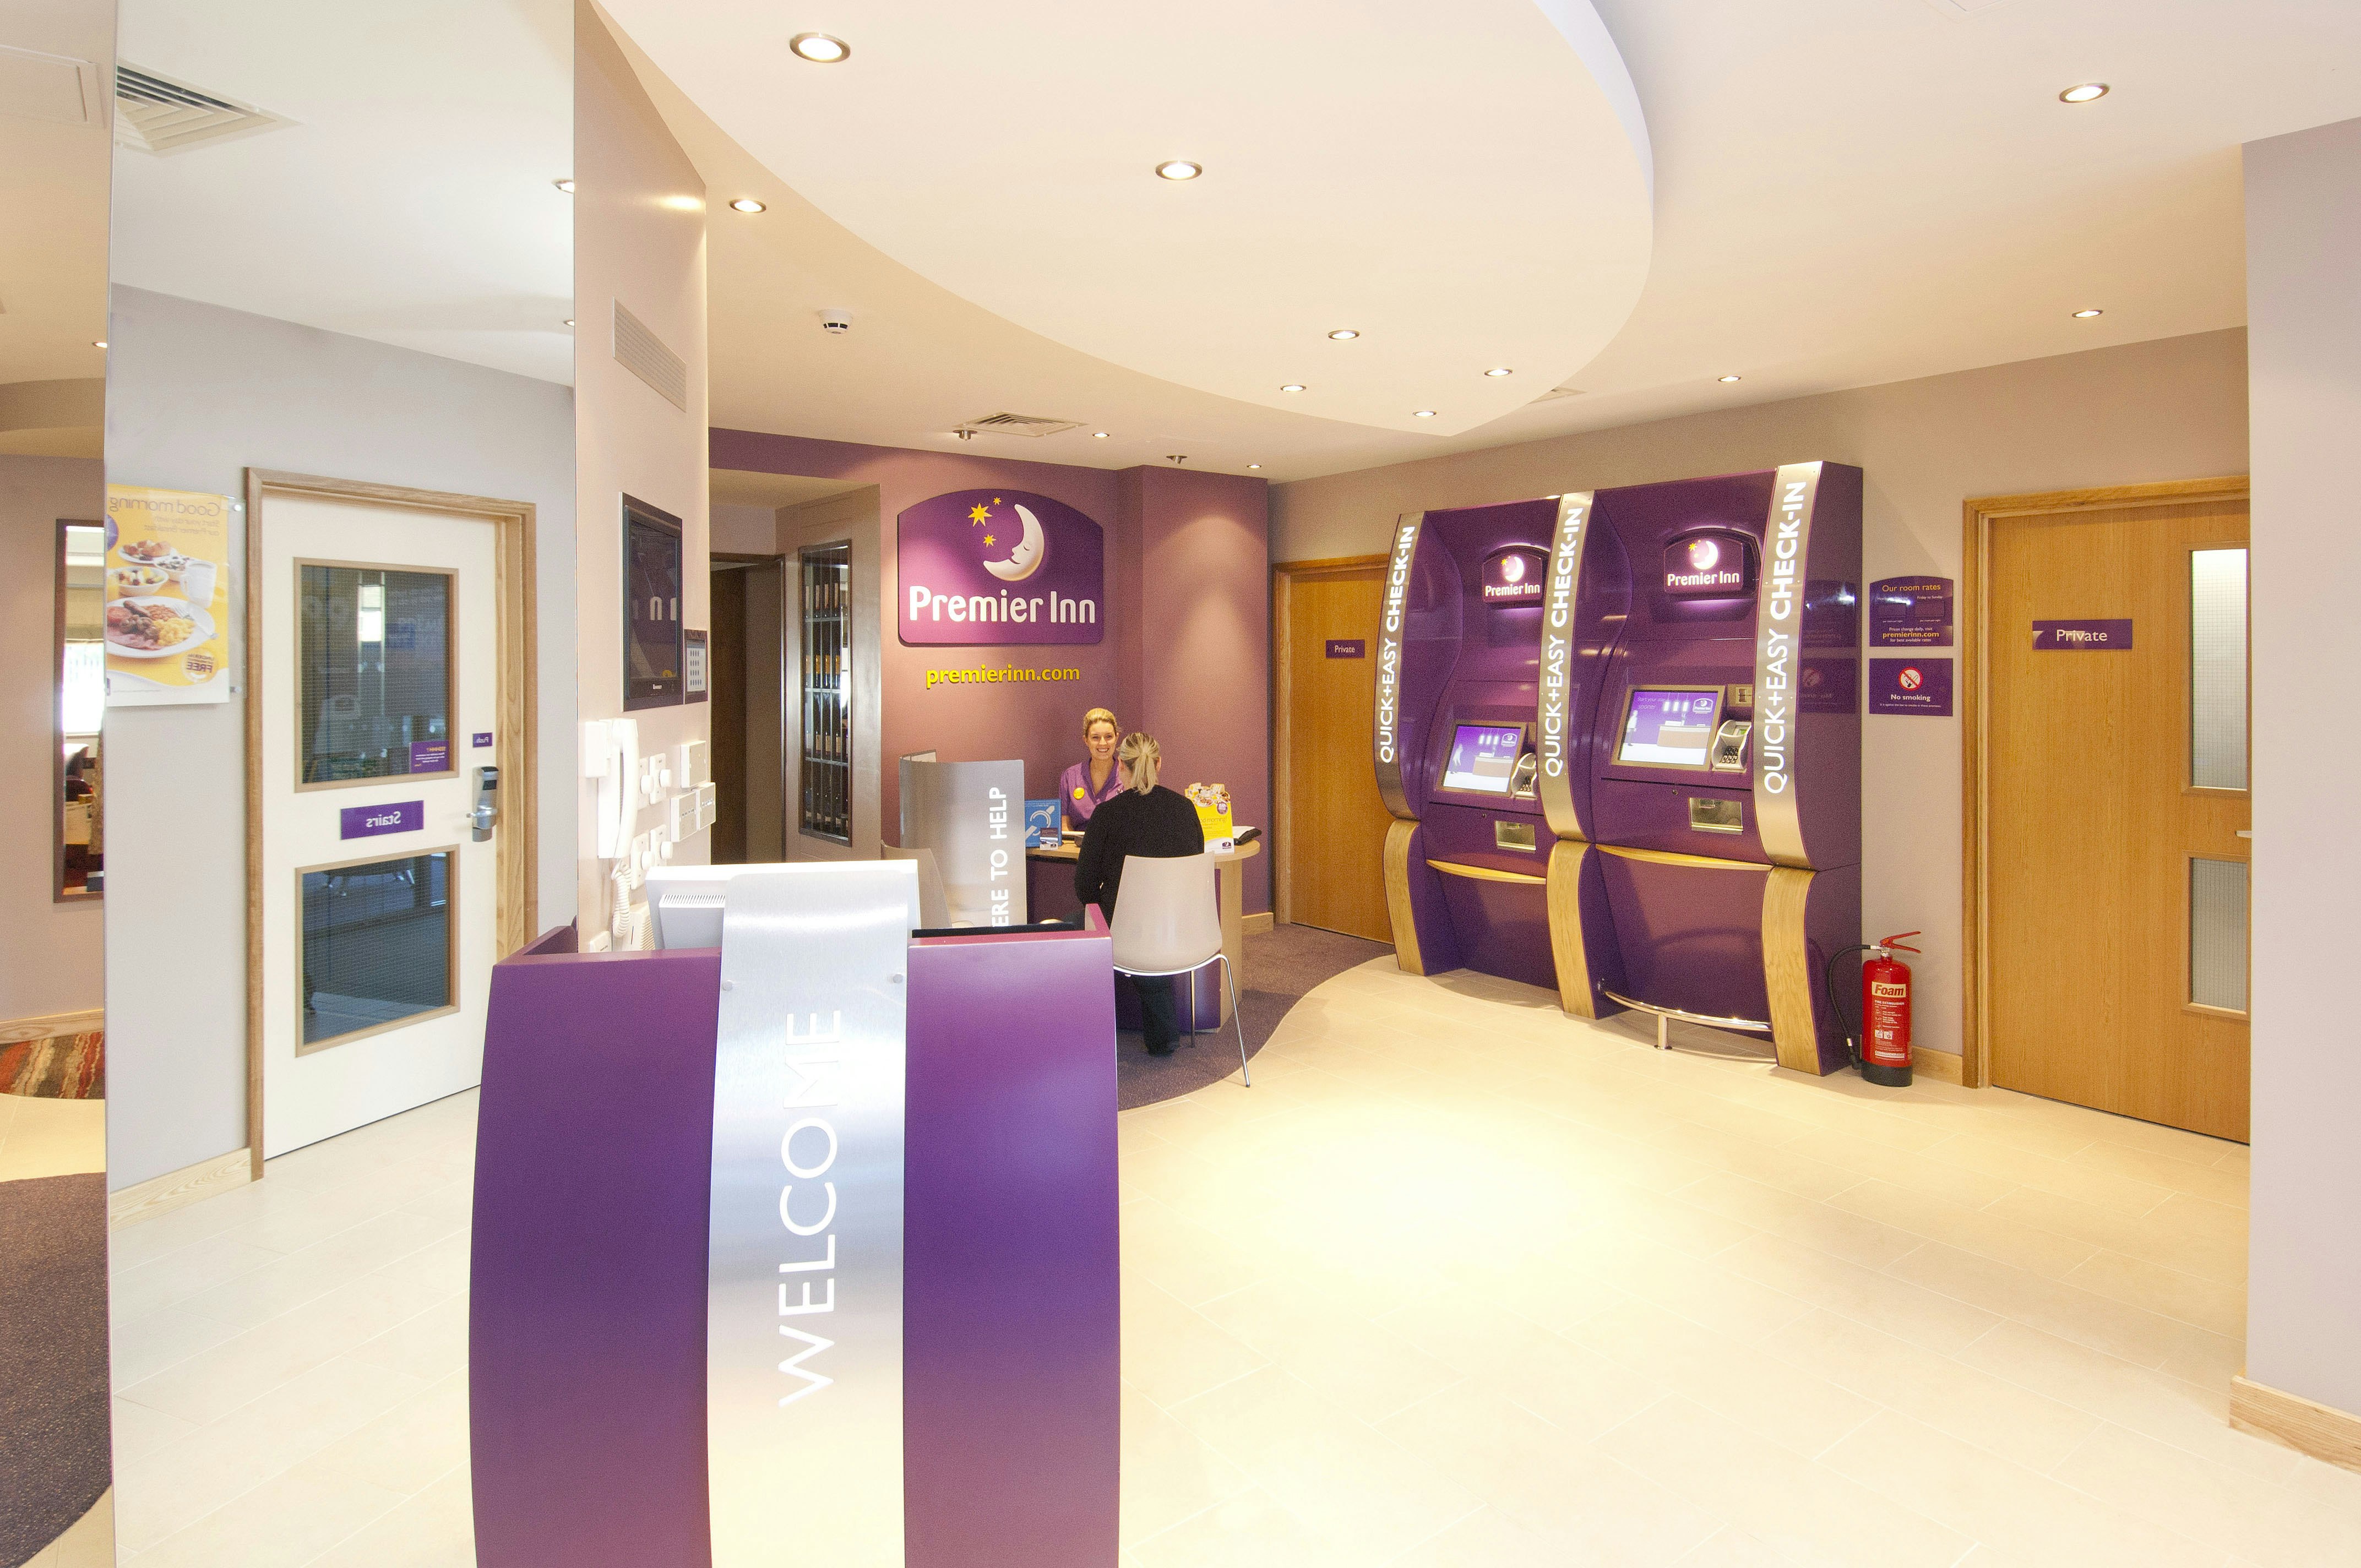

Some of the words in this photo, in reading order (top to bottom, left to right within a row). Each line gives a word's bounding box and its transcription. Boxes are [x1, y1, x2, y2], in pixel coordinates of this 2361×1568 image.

[1551, 508, 1583, 627] CHECK-IN
[1770, 482, 1806, 620] CHECK-IN
[1386, 526, 1415, 632] CHECK-IN
[1485, 583, 1524, 597] Premier
[1525, 582, 1540, 594] Inn
[1667, 571, 1718, 586] Premier
[1720, 570, 1740, 584] Inn
[910, 585, 1043, 623] Premier
[1050, 591, 1095, 623] Inn
[1335, 645, 1355, 653] Private
[2056, 629, 2108, 641] Private
[926, 663, 1080, 689] premierinn.com
[1380, 638, 1397, 763] QUICK+EASY
[1545, 634, 1565, 777] QUICK+EASY
[1764, 628, 1788, 793] QUICK+EASY
[1902, 694, 1931, 703] smoking
[989, 787, 1008, 839] HELP
[990, 849, 1008, 881] TO
[991, 889, 1009, 927] ERE
[1874, 984, 1904, 996] Foam
[779, 1010, 841, 1407] WELCOME
